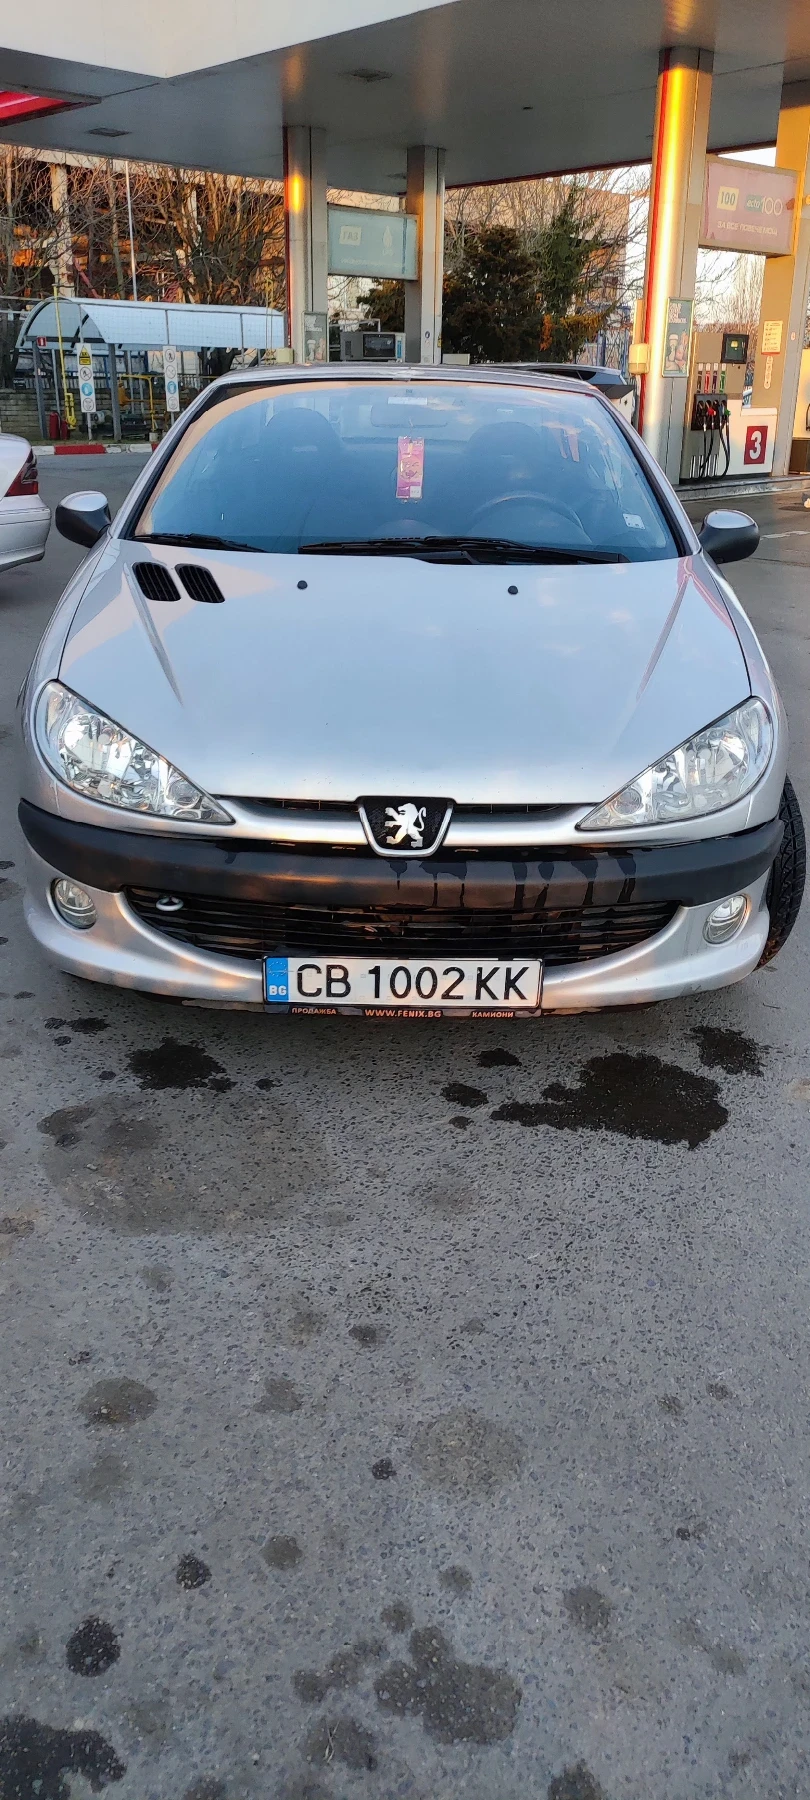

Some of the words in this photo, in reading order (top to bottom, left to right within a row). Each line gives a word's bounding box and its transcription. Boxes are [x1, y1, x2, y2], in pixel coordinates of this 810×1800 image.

[720, 191, 736, 206] 100
[342, 231, 359, 241] ГАЗ
[749, 430, 763, 460] 3
[296, 963, 352, 999] CB
[367, 964, 465, 1001] 1002
[474, 966, 531, 1001] KK
[268, 985, 288, 996] BG
[291, 1007, 337, 1015] ПРОДАЖБА
[364, 1008, 442, 1019] WWW.FENIX.BG
[471, 1011, 515, 1019] КАМИОНИ
